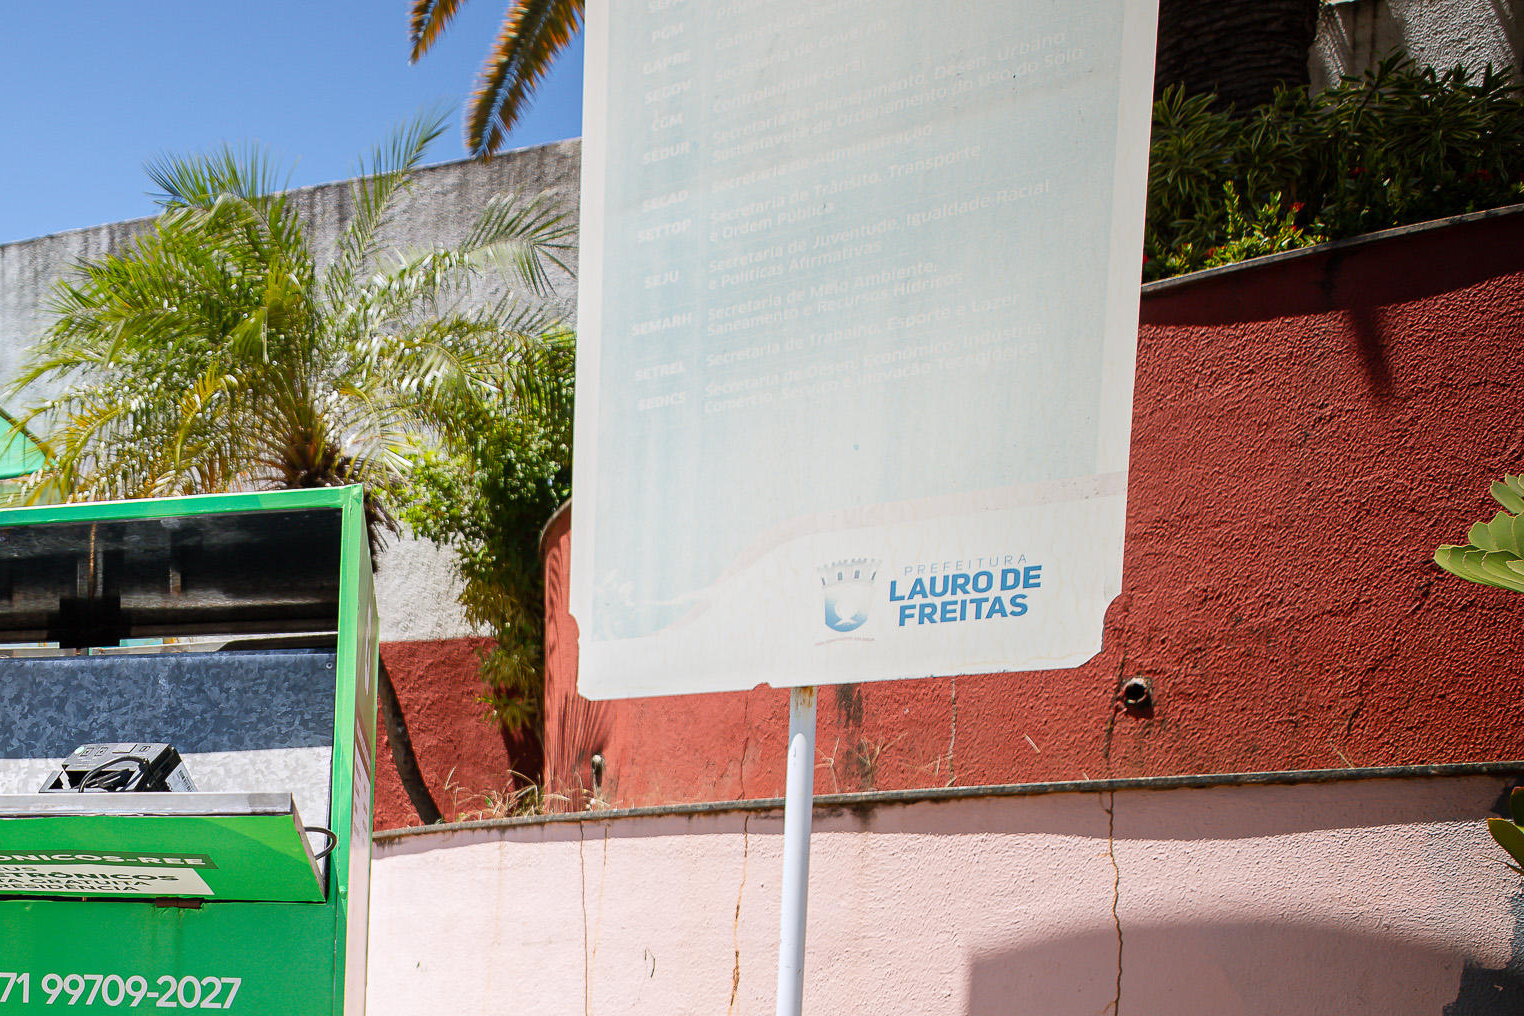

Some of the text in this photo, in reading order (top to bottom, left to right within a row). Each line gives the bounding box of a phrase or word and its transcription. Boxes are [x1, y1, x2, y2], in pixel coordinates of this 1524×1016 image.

[652, 22, 684, 43] PGM
[715, 20, 781, 50] Gabinete
[643, 50, 692, 75] GAPRE
[715, 20, 888, 83] Secretaria de Governo
[644, 78, 692, 105] SEGOV
[712, 112, 787, 145] Secretaria
[791, 105, 809, 121] de
[997, 31, 1065, 61] Urbano
[712, 127, 796, 163] Sustentável
[813, 115, 833, 134] de
[837, 86, 947, 127] Ordenamento
[952, 78, 973, 96] do
[978, 69, 1011, 88] Uso
[1016, 60, 1039, 78] do
[1044, 47, 1083, 68] Solo
[652, 112, 683, 132] CGM
[643, 141, 690, 165] SEDUR
[711, 124, 933, 194] Secretaria de Administração
[642, 190, 688, 212] SECAD
[710, 194, 786, 225] Secretaria
[789, 188, 809, 205] de
[888, 144, 981, 179] Transporte
[637, 219, 692, 244] SETTOP
[709, 200, 834, 242] e Ordem Pública
[709, 243, 783, 273] Secretaria
[788, 236, 807, 255] de
[907, 195, 991, 227] Igualdade
[996, 178, 1050, 204] Racial
[644, 270, 679, 289] SEJU
[708, 239, 881, 290] e Políticas Afirmativas
[706, 271, 963, 337] Saneamento e Recursos Hídricos
[707, 290, 781, 321] Secretaria
[786, 285, 805, 301] de
[810, 277, 848, 299] Meio
[632, 312, 692, 336] SEMARH
[706, 337, 780, 368] Secretaria
[784, 333, 804, 351] de
[887, 306, 951, 331] Esporte
[956, 304, 966, 316] e
[972, 293, 1020, 313] Lazer
[635, 360, 686, 382] SETREL
[705, 367, 779, 398] Secretaria
[783, 364, 803, 383] de
[842, 376, 852, 389] e
[857, 362, 931, 387] Inovação
[936, 341, 1038, 370] Tecnológica
[637, 391, 687, 411] SEDICS
[904, 553, 1027, 576] PREFEITURA
[889, 565, 1043, 602] LAURO DE
[898, 594, 1028, 627] FREITAS
[30, 878, 151, 886] GRATUITA
[41, 972, 241, 1009] 99709-2027
